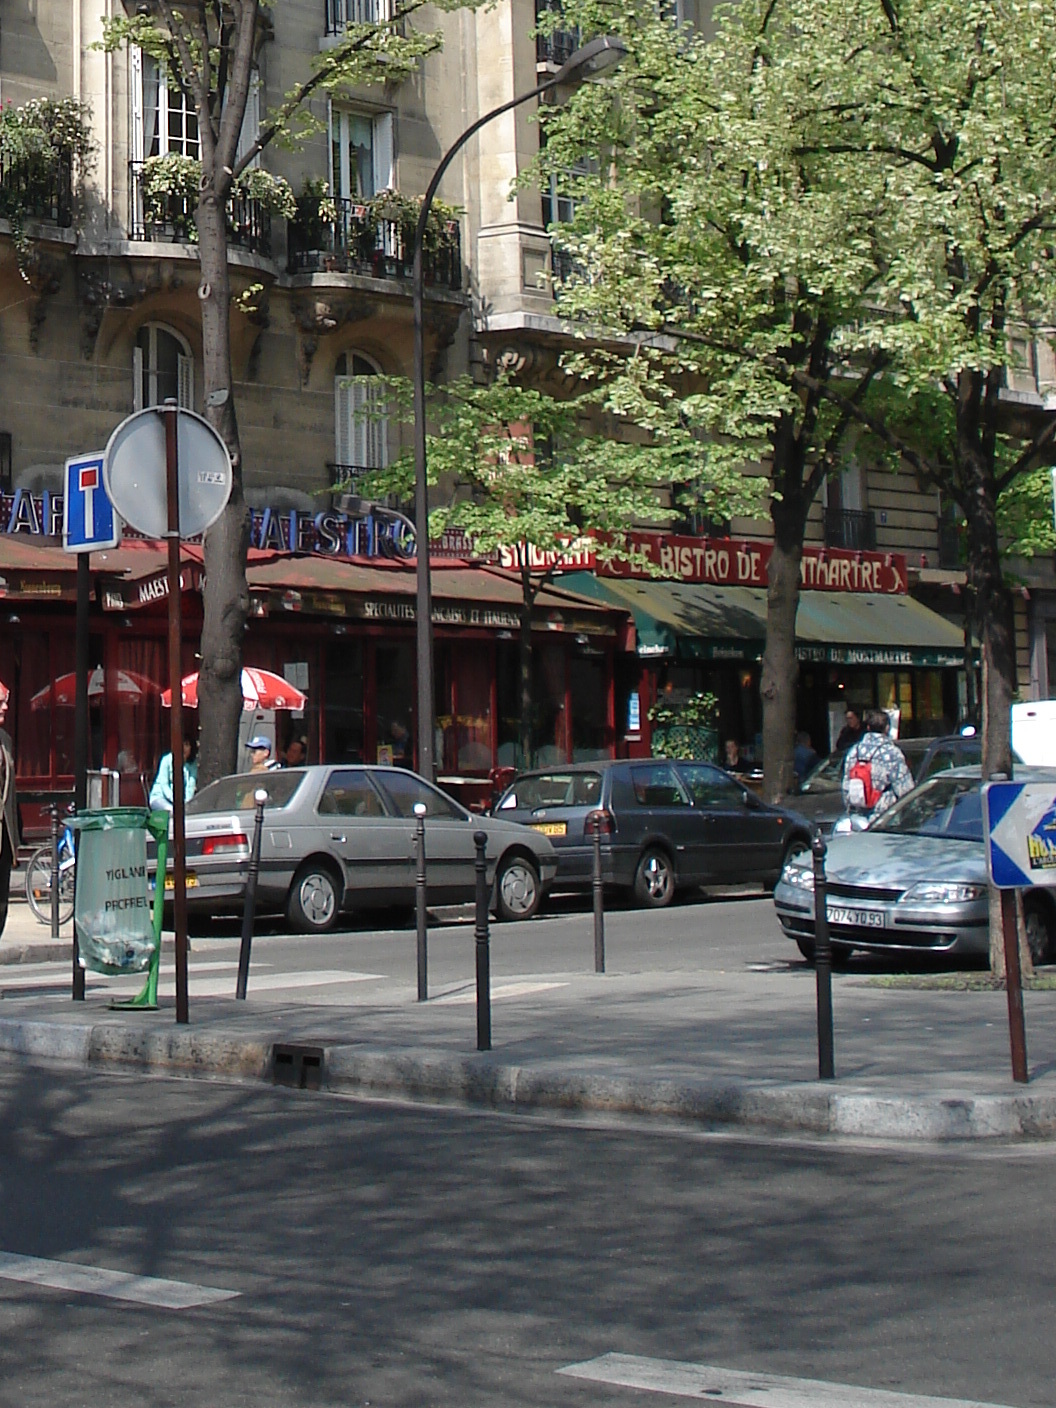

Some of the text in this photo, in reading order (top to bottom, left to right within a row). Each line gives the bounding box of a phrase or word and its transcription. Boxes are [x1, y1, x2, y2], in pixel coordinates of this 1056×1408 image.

[249, 506, 417, 560] AESTRO
[660, 545, 730, 582] BISTRO
[737, 551, 761, 581] DE
